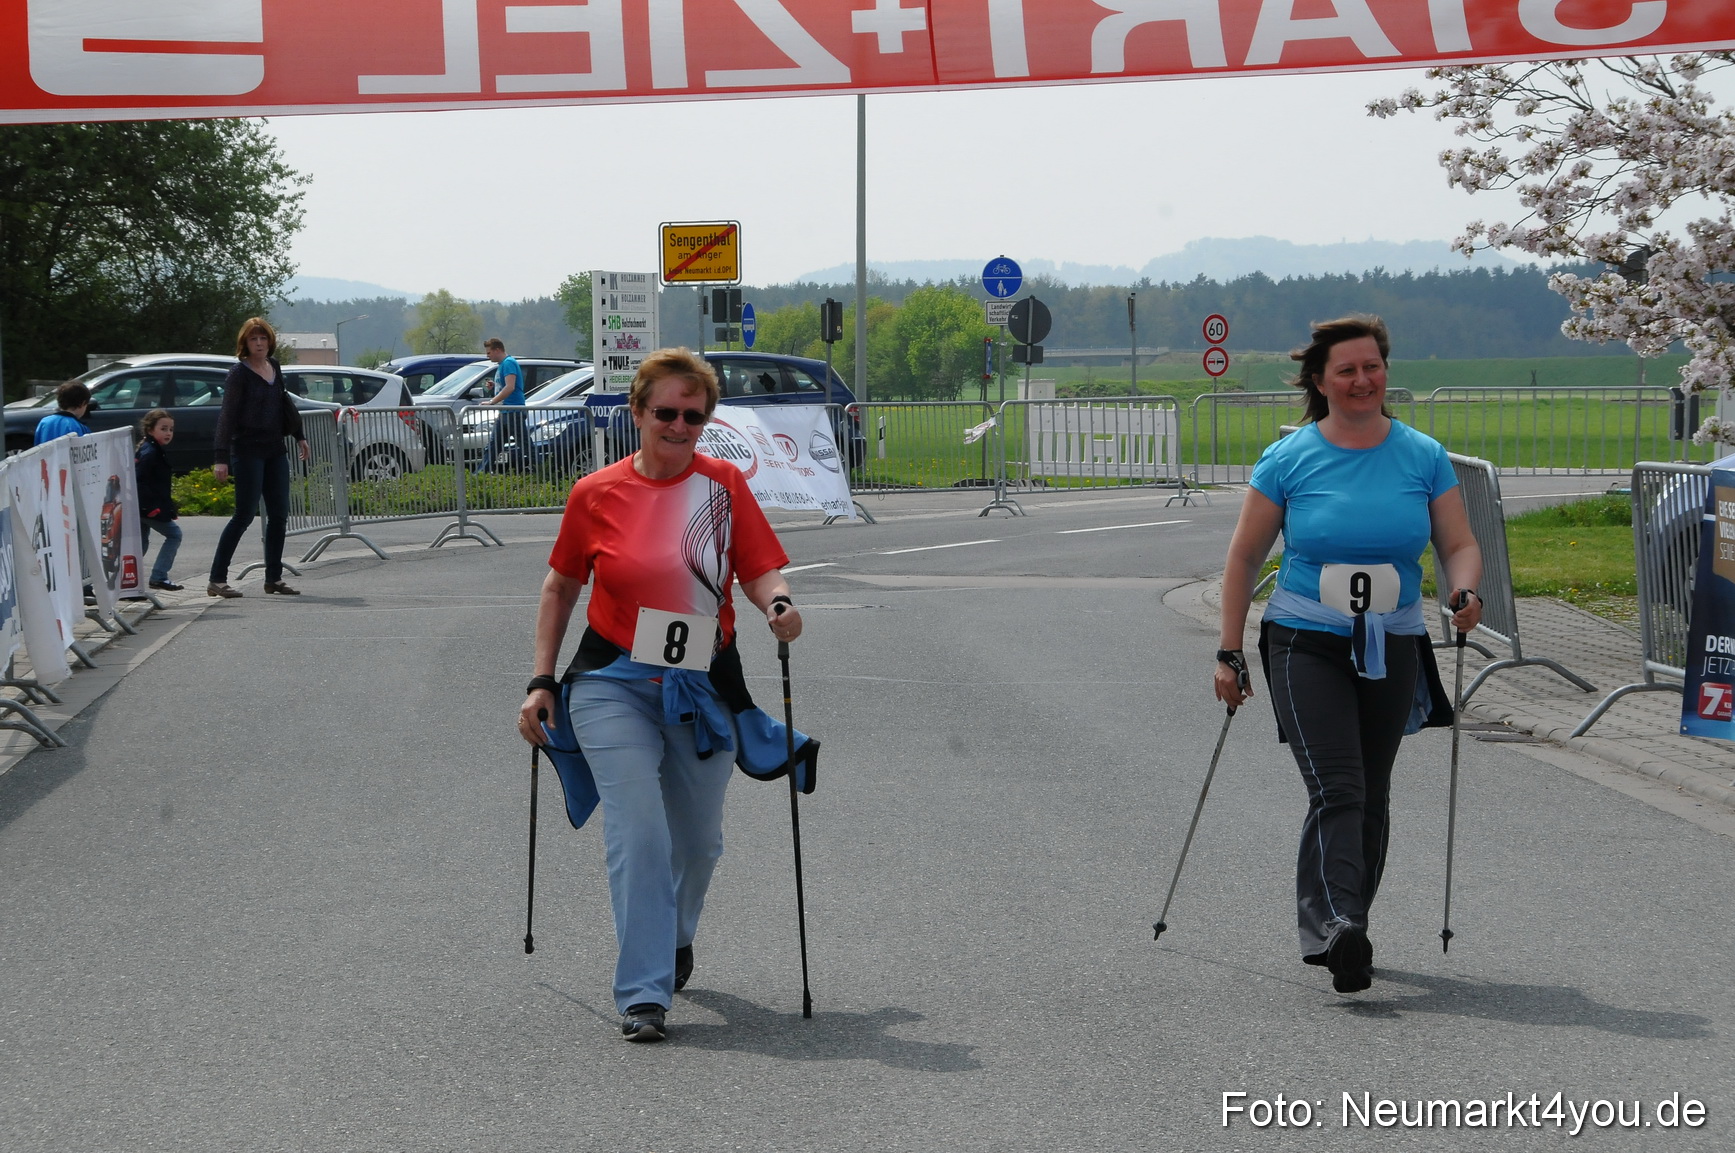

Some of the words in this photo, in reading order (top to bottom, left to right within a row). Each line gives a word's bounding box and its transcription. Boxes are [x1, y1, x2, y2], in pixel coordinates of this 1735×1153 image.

[669, 232, 731, 250] Sengenthal
[677, 252, 691, 260] am
[697, 251, 723, 261] Anger
[684, 266, 712, 275] Neumarkt
[608, 314, 622, 330] SHB
[1208, 322, 1224, 336] 60
[608, 355, 630, 370] THULE
[1350, 571, 1372, 614] 9
[663, 620, 690, 665] 8
[1701, 686, 1724, 715] 7
